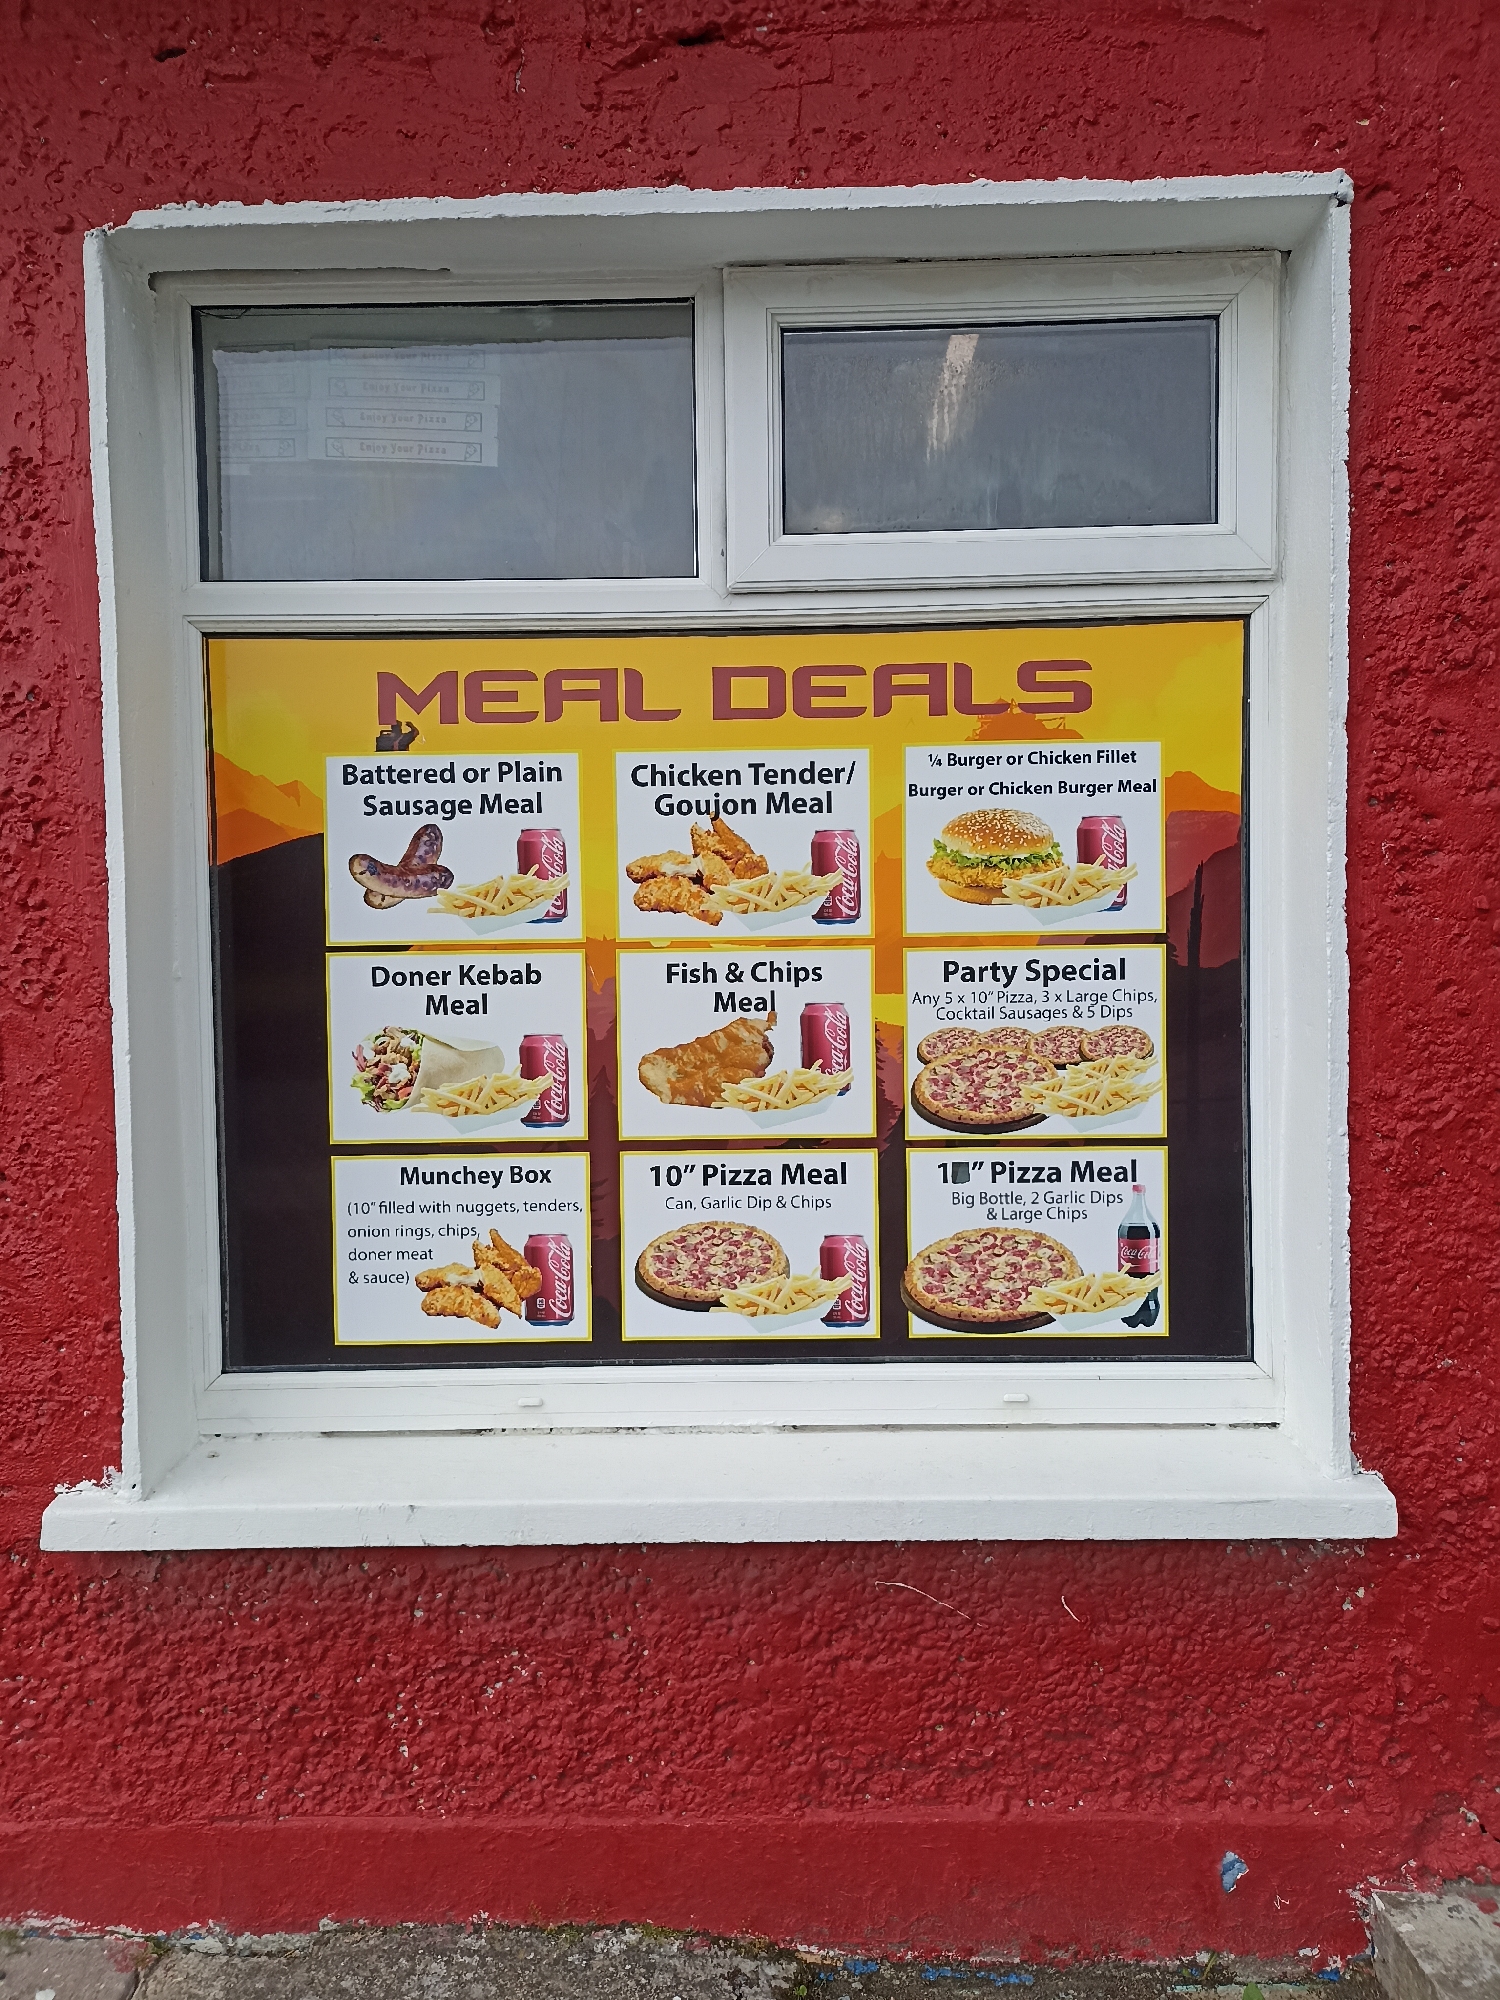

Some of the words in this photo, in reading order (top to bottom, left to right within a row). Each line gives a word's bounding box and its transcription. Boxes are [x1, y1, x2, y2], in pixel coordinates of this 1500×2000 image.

[360, 412, 387, 423] Enjoy
[391, 413, 413, 423] Your
[418, 414, 447, 424] Pizza
[360, 442, 387, 453] Enjoy
[391, 444, 413, 454] Your
[417, 444, 446, 455] Pizza
[376, 667, 682, 726] MEAL
[711, 659, 1094, 720] DEALS
[948, 753, 1002, 769] Burger
[1006, 755, 1023, 765] or
[1028, 750, 1091, 764] Chicken
[1097, 750, 1136, 763] Fillet
[343, 762, 455, 785] Battered
[463, 768, 490, 783] or
[498, 761, 562, 782] Plain
[631, 763, 741, 787] Chicken
[748, 761, 856, 785] Tender/
[909, 784, 963, 800] Burger
[968, 786, 984, 795] or
[989, 781, 1052, 795] Chicken
[1059, 781, 1113, 797] Burger
[1118, 779, 1156, 792] Meal
[364, 795, 472, 821] Sausage
[480, 792, 542, 814] Meal
[655, 792, 756, 819] Goujon
[766, 791, 832, 814] Meal
[372, 966, 451, 987] Doner
[459, 963, 541, 985] Kebab
[667, 962, 717, 983] Fish
[725, 962, 744, 983] &
[751, 961, 822, 987] Chips
[944, 961, 1018, 988] Party
[1026, 958, 1125, 987] Special
[426, 993, 487, 1015] Meal
[714, 990, 775, 1012] Meal
[912, 993, 940, 1007] Any
[945, 992, 953, 1004] 5
[957, 995, 964, 1003] x
[997, 991, 1037, 1005] Pizza,
[1042, 991, 1049, 1002] 3
[1055, 994, 1062, 1002] x
[1067, 990, 1108, 1006] Large
[1112, 989, 1158, 1004] Chips,
[936, 1007, 995, 1021] Cocktail
[1000, 1007, 1067, 1022] Sausages
[1072, 1007, 1083, 1018] &
[1087, 1006, 1095, 1018] 5
[1101, 1005, 1133, 1021] Dips
[401, 1166, 503, 1189] Munchey
[510, 1166, 551, 1183] Box
[703, 1164, 771, 1186] Pizza
[781, 1162, 846, 1185] Meal
[938, 1161, 984, 1184] 1"
[991, 1161, 1062, 1184] Pizza
[1070, 1159, 1137, 1183] Meal
[379, 1201, 414, 1213] filled
[419, 1201, 450, 1213] with
[456, 1200, 519, 1216] nuggets,
[523, 1199, 582, 1213] tenders,
[666, 1197, 697, 1211] Can,
[701, 1197, 743, 1209] Garlic
[748, 1196, 772, 1211] Dip
[776, 1197, 786, 1208] &
[790, 1195, 831, 1211] Chips
[952, 1192, 974, 1208] Big
[980, 1192, 1026, 1207] Bottle,
[1031, 1192, 1039, 1204] 2
[1044, 1191, 1085, 1204] Garlic
[1091, 1191, 1123, 1207] Dips
[987, 1208, 997, 1220] &
[1001, 1207, 1042, 1223] Large
[1047, 1207, 1087, 1222] Chips
[348, 1226, 390, 1237] onion
[395, 1225, 434, 1240] rings,
[438, 1224, 480, 1240] chips,
[348, 1249, 392, 1261] doner
[397, 1249, 433, 1260] meat
[349, 1272, 359, 1284] &
[364, 1271, 410, 1285] sauce)
